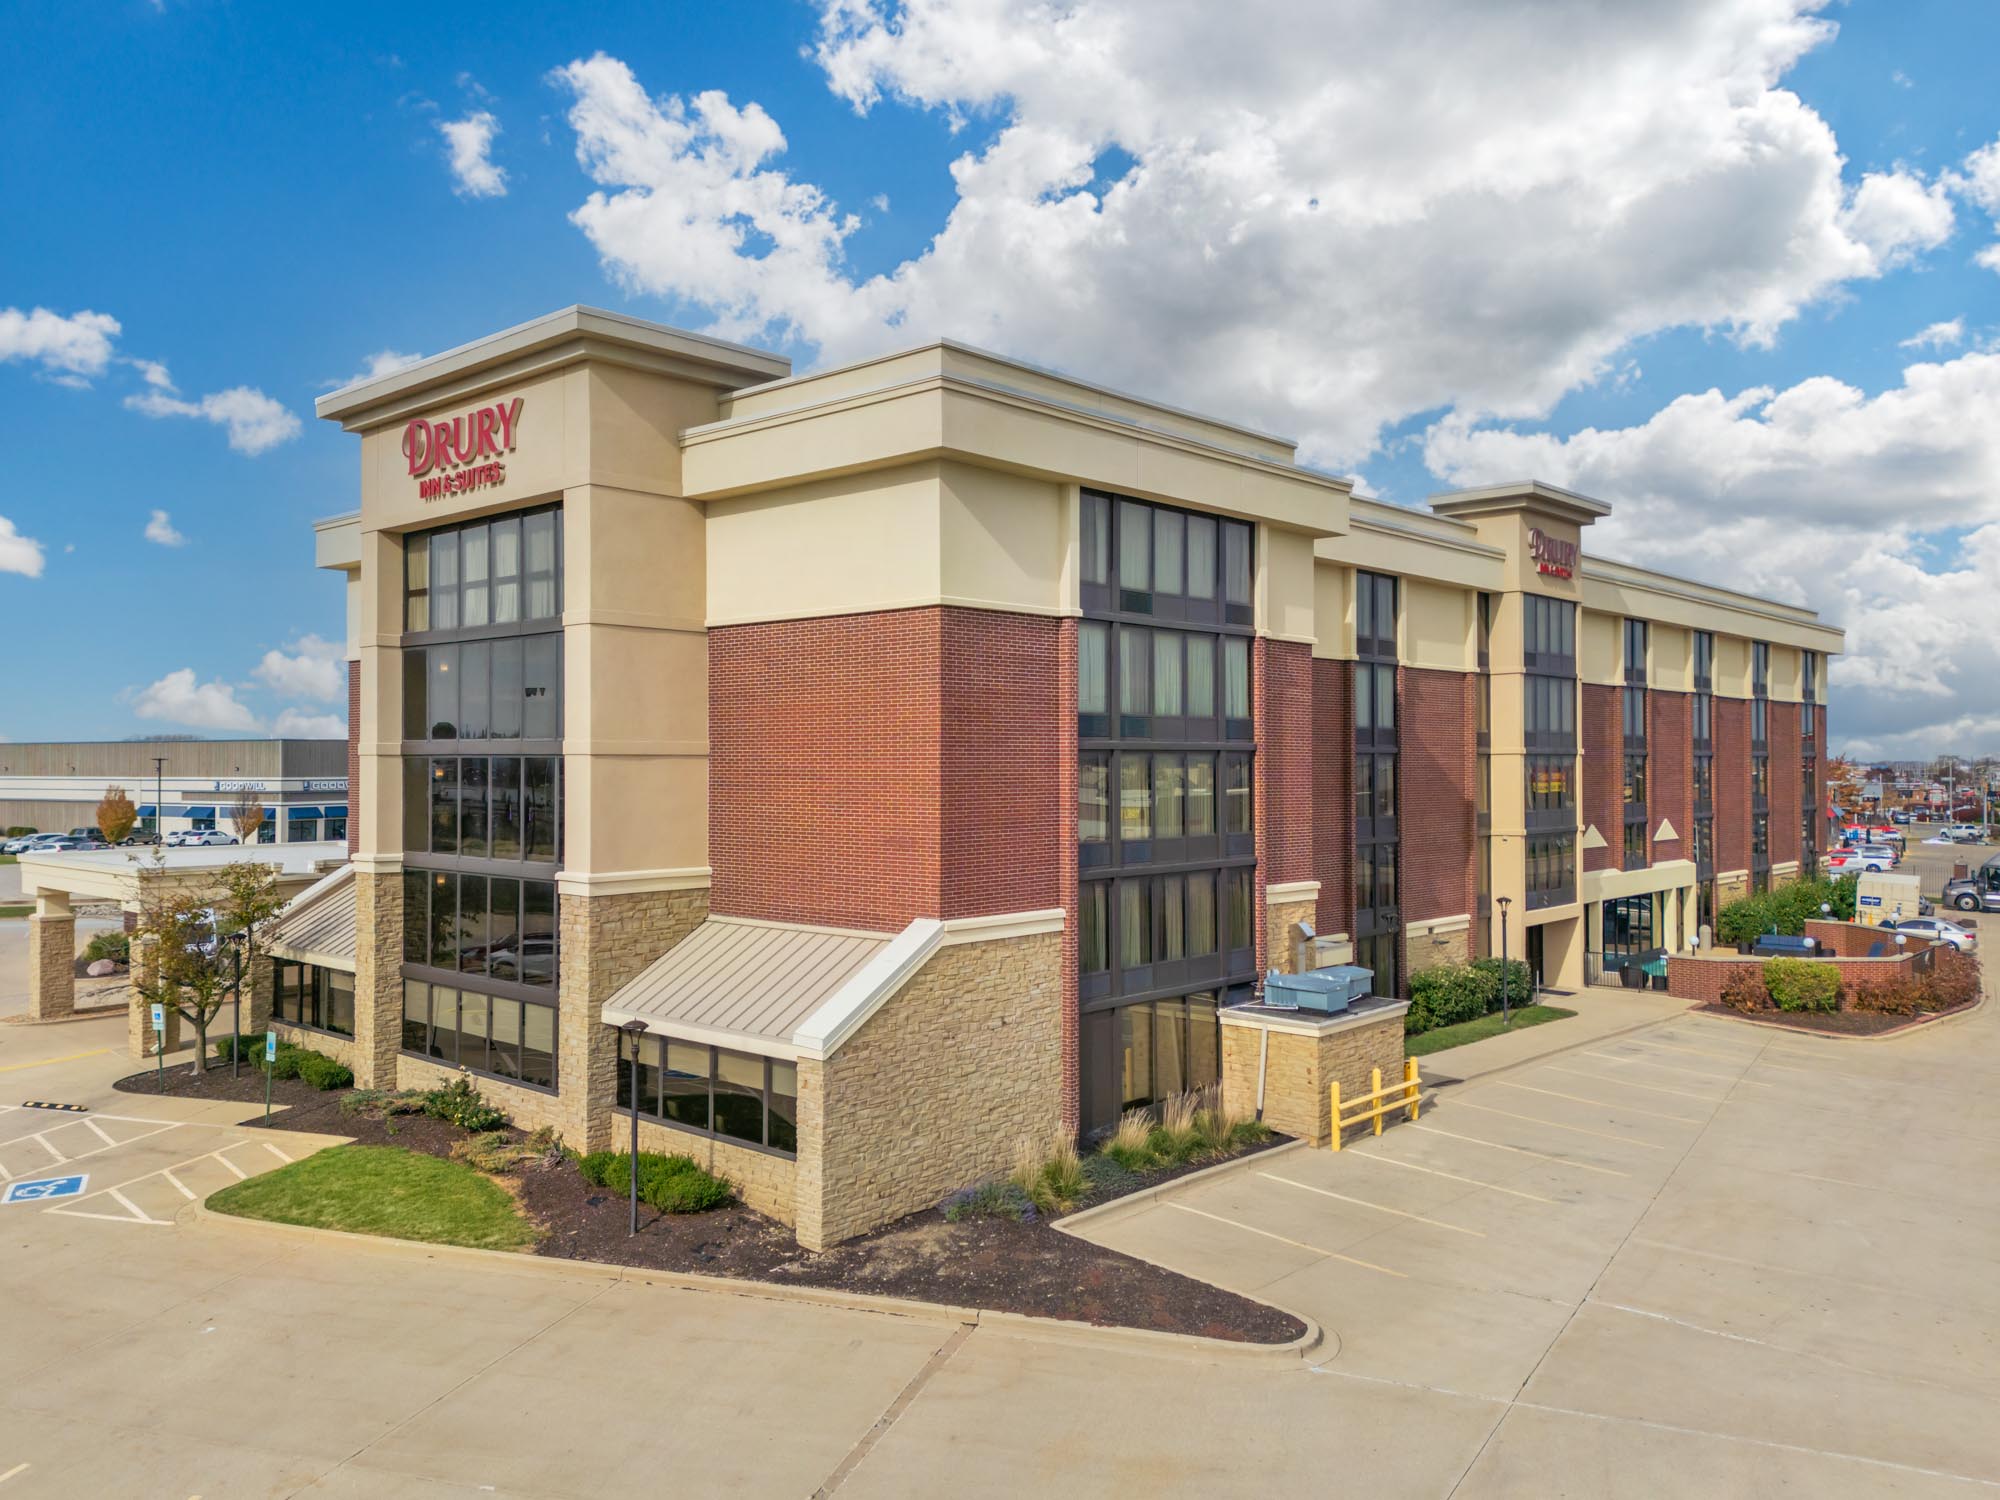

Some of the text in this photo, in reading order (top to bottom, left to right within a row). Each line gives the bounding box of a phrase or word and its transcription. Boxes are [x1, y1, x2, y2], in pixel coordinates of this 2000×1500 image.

[402, 397, 523, 478] DRURY
[419, 461, 504, 500] INN & SUITES
[219, 781, 266, 791] GOODWILL
